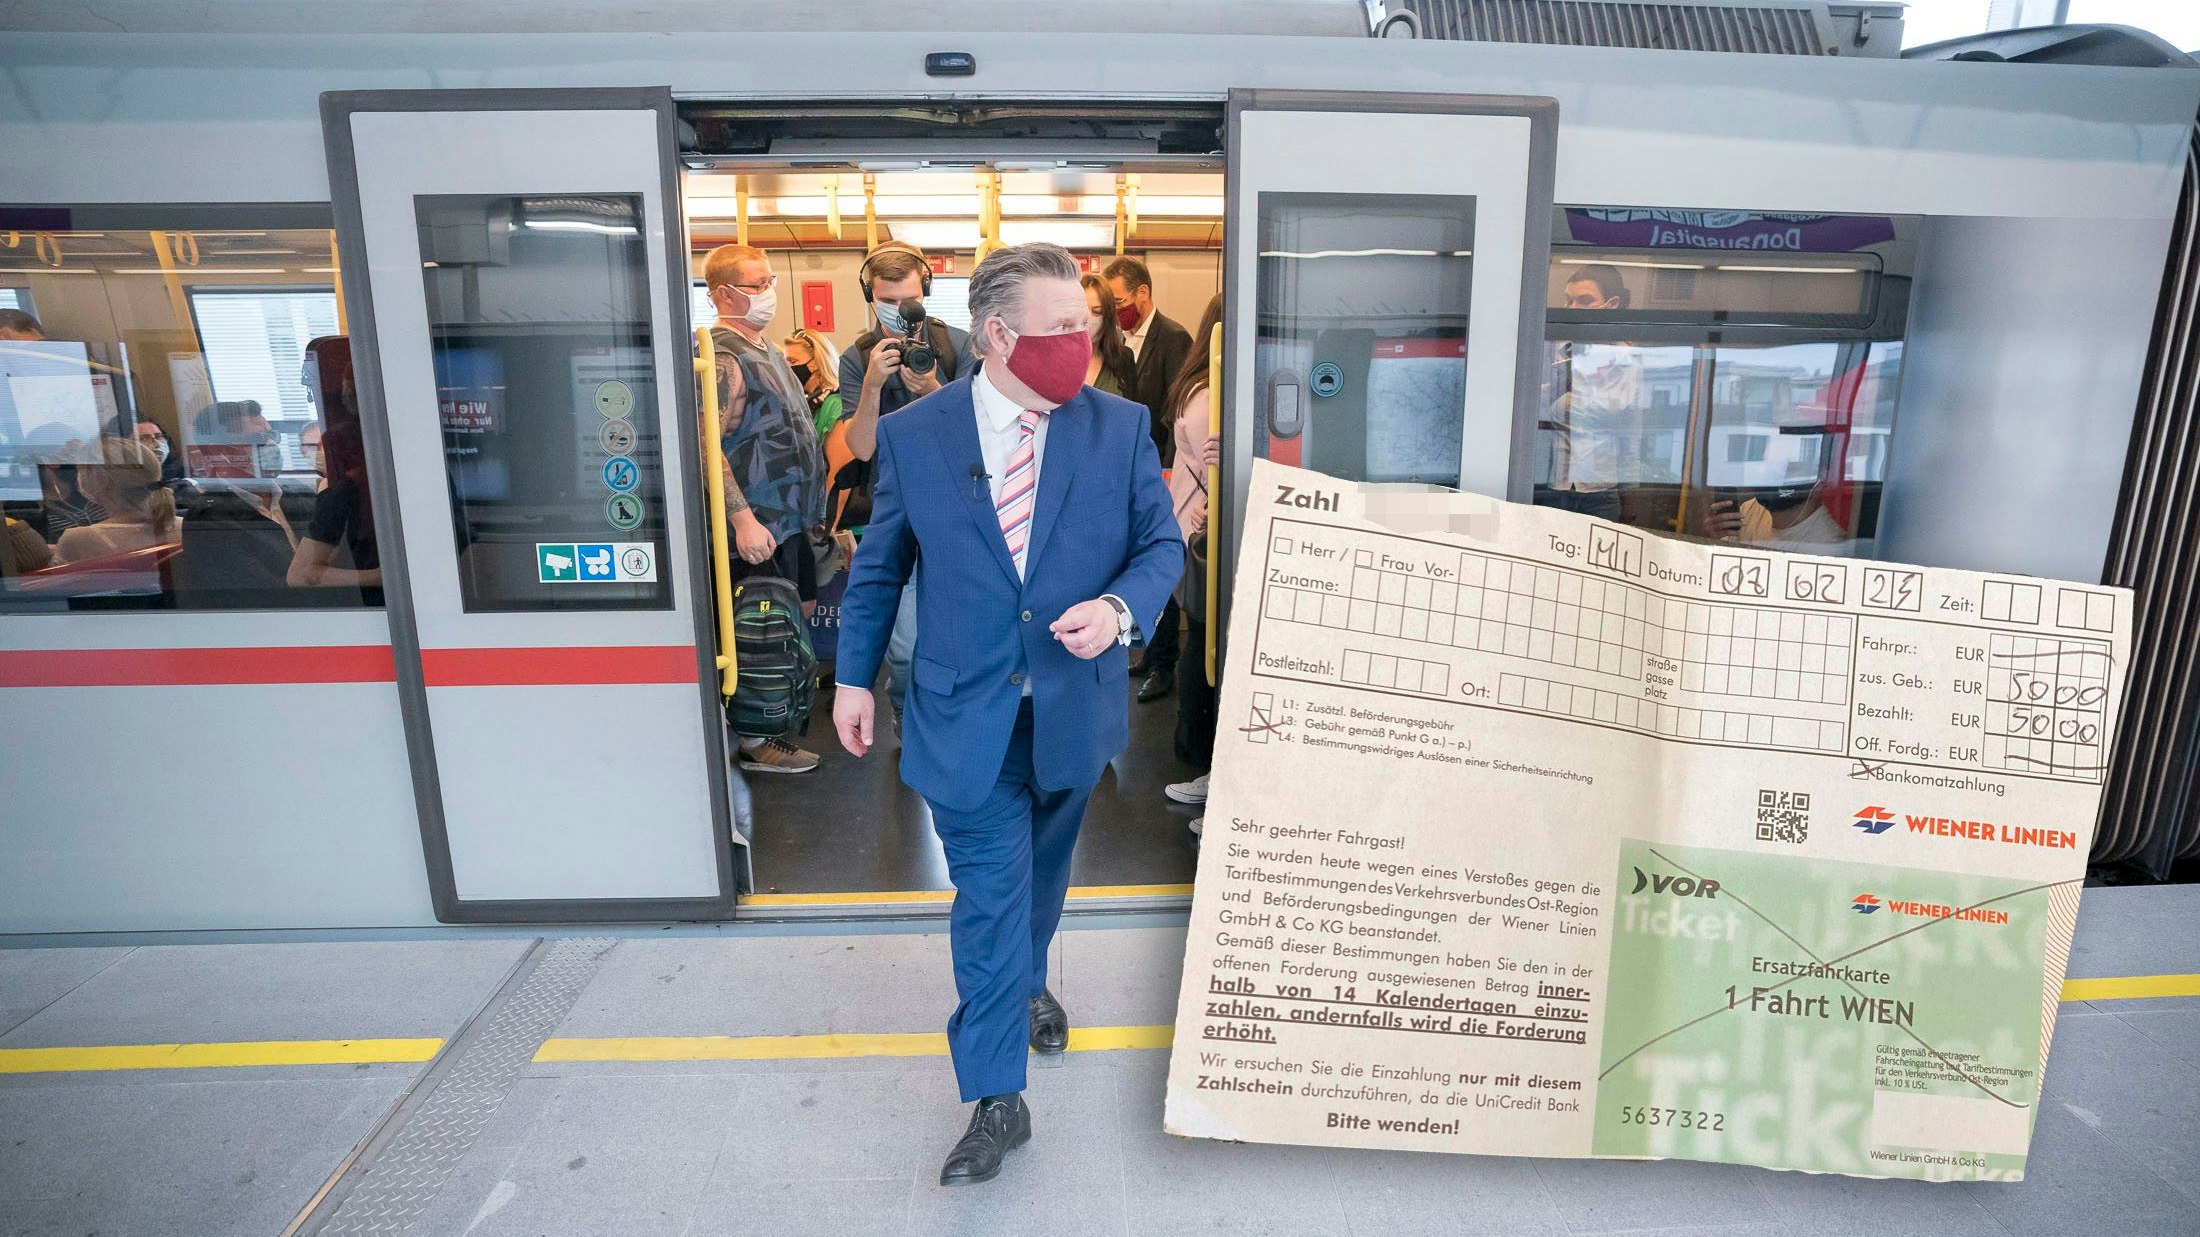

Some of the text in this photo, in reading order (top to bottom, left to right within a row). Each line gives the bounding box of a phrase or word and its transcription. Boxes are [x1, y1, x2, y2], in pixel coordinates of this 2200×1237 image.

[1274, 485, 1339, 512] Zahl
[1548, 534, 1581, 558] Tag:
[1301, 541, 1336, 559] Herr
[1381, 555, 1414, 572] Frau
[1425, 562, 1454, 579] Vor-
[1268, 568, 1339, 592] Zuname:
[1649, 561, 1702, 586] Datum:
[1940, 595, 1974, 613] Zeit:
[1862, 637, 1985, 662] Fahrpr.: EUR
[1258, 652, 1334, 675] Postleitzahl:
[1647, 657, 1678, 672] straße
[1461, 682, 1490, 698] Ort:
[1646, 671, 1674, 686] gasse
[1859, 673, 1982, 695] zus. Geb.: EUR
[1645, 686, 1667, 700] platz
[1282, 699, 1454, 731] L1: Zusätzl. Beförderungsgebühr
[1857, 703, 1980, 728] Bezahlt: EUR
[1281, 715, 1297, 726] L3:
[1305, 718, 1345, 732] Gebühr
[1348, 726, 1385, 738] gemäß
[1388, 729, 1417, 742] Punkt
[1420, 734, 1430, 744] G
[1278, 732, 1593, 785] L4: Bestimmungswidriges Auslösen einer Sicherheitseinrichtung
[1855, 736, 1978, 762] Off. Fordg.: EUR
[1876, 768, 2005, 796] Bankomatzahlung
[1231, 818, 1405, 849] Sehr geehrter Fahrgast!
[1905, 815, 2076, 849] WIENER LINIEN
[1228, 843, 1600, 896] Sie wurden heute wegen eines Verstoßes gegen die
[1225, 865, 1598, 917] Tarifbestimmungen des Verkehrsverbundes Ost-Region
[1652, 874, 1720, 899] VOR
[1222, 889, 1596, 937] und Beförderungsbedingungen der Wiener Linien
[1888, 901, 2008, 924] WIENER LINIEN
[1219, 910, 1441, 943] GmbH & Co KG beanstandet.
[1216, 932, 1592, 978] Gemäß dieser Bestimmungen haben Sie den in der
[1213, 955, 1590, 999] offenen Forderung ausgewiesenen Betrag inner-
[1752, 957, 1890, 984] Ersatzfahrkarte
[1210, 975, 1588, 1020] halb von 14 Kalendertagen einzu-
[1725, 985, 1914, 1026] 1 Fahrt WIEN
[1203, 1022, 1276, 1041] erhöht.
[1206, 999, 1586, 1044] zahlen, andernfalls wird die Forderung
[1876, 1045, 1980, 1062] Gültig gemäß eingetragener
[1200, 1052, 1581, 1090] Wir ersuchen Sie die Einzahlung nur mit diesem
[1875, 1067, 2008, 1086] für den Verkehrsverbund Ost-Region
[1876, 1056, 1944, 1071] Fahrscheingattung
[1963, 1064, 2033, 1077] Tarifbestimmungen
[1196, 1075, 1579, 1112] Zahlschein durchzuführen, da die UniCredit Bank
[1894, 1079, 1902, 1087] 10
[1327, 1112, 1460, 1134] Bitte wenden!
[1622, 1106, 1724, 1131] 5637322
[1870, 1151, 1985, 1167] Wiener Linien GmbH & Co KG
